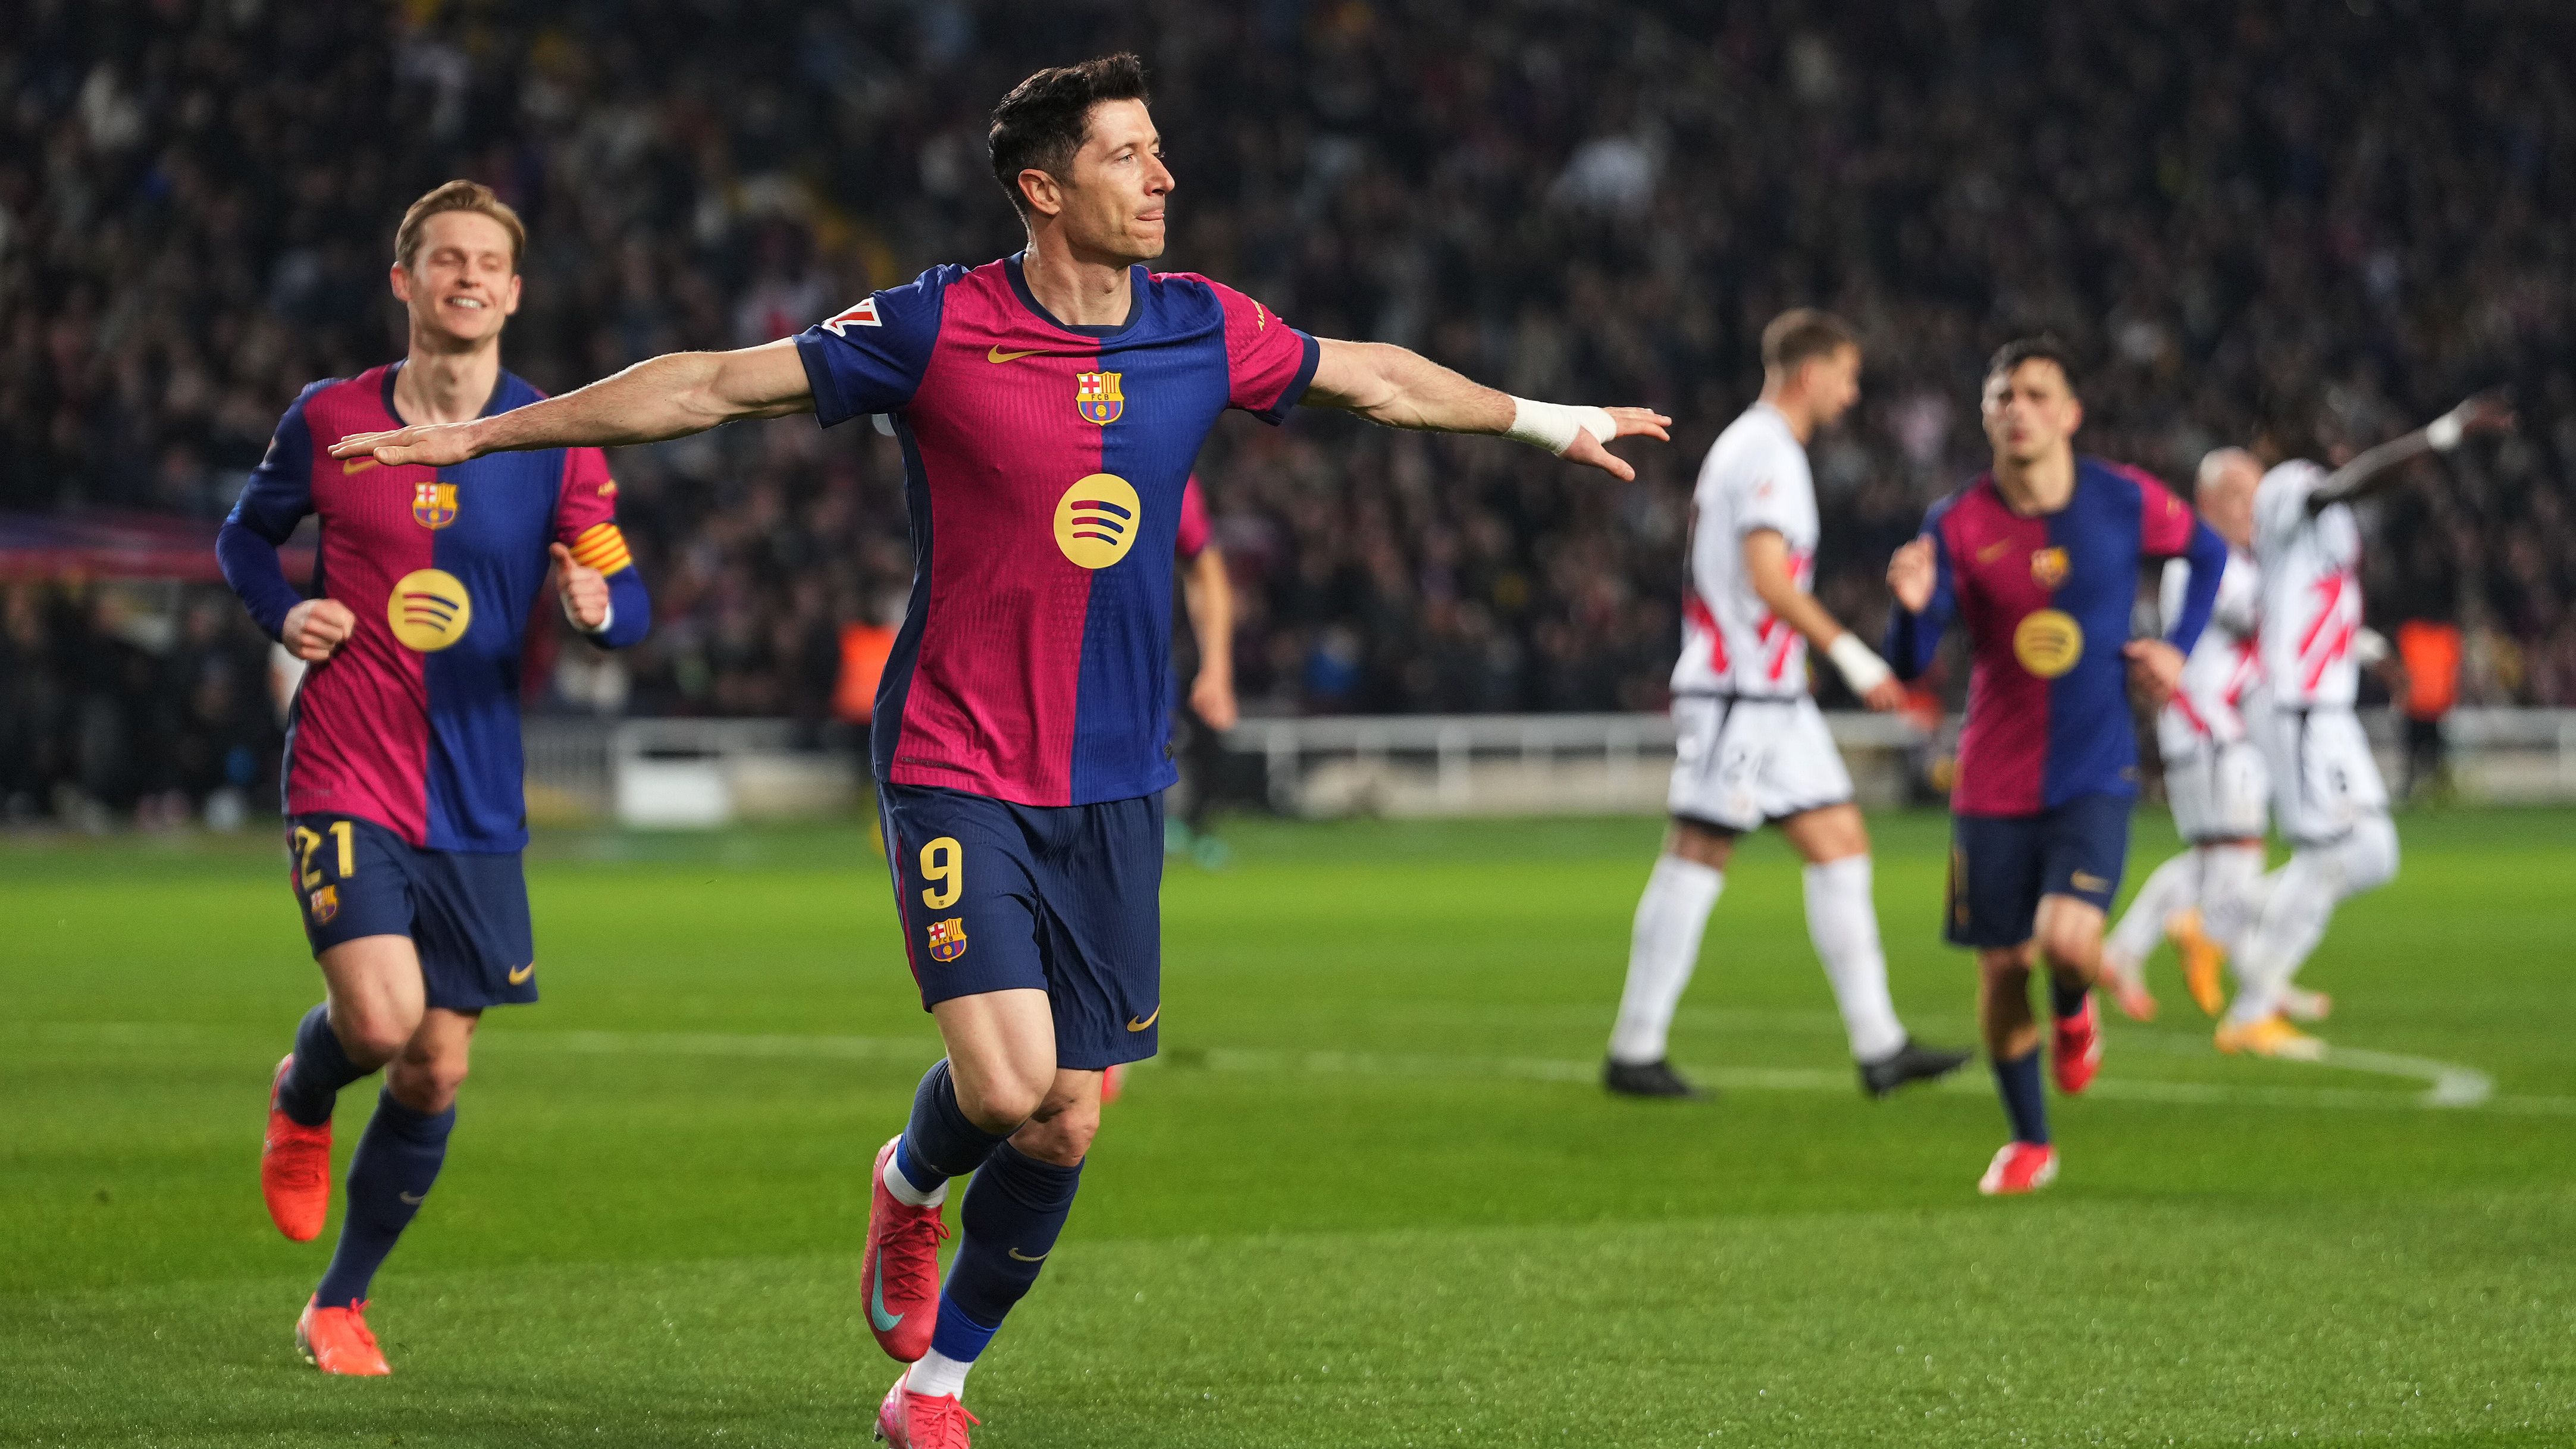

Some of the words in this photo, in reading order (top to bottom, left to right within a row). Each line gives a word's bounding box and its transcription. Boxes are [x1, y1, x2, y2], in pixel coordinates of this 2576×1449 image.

[294, 820, 353, 890] 21
[920, 836, 963, 909] 9
[938, 936, 953, 944] FCB
